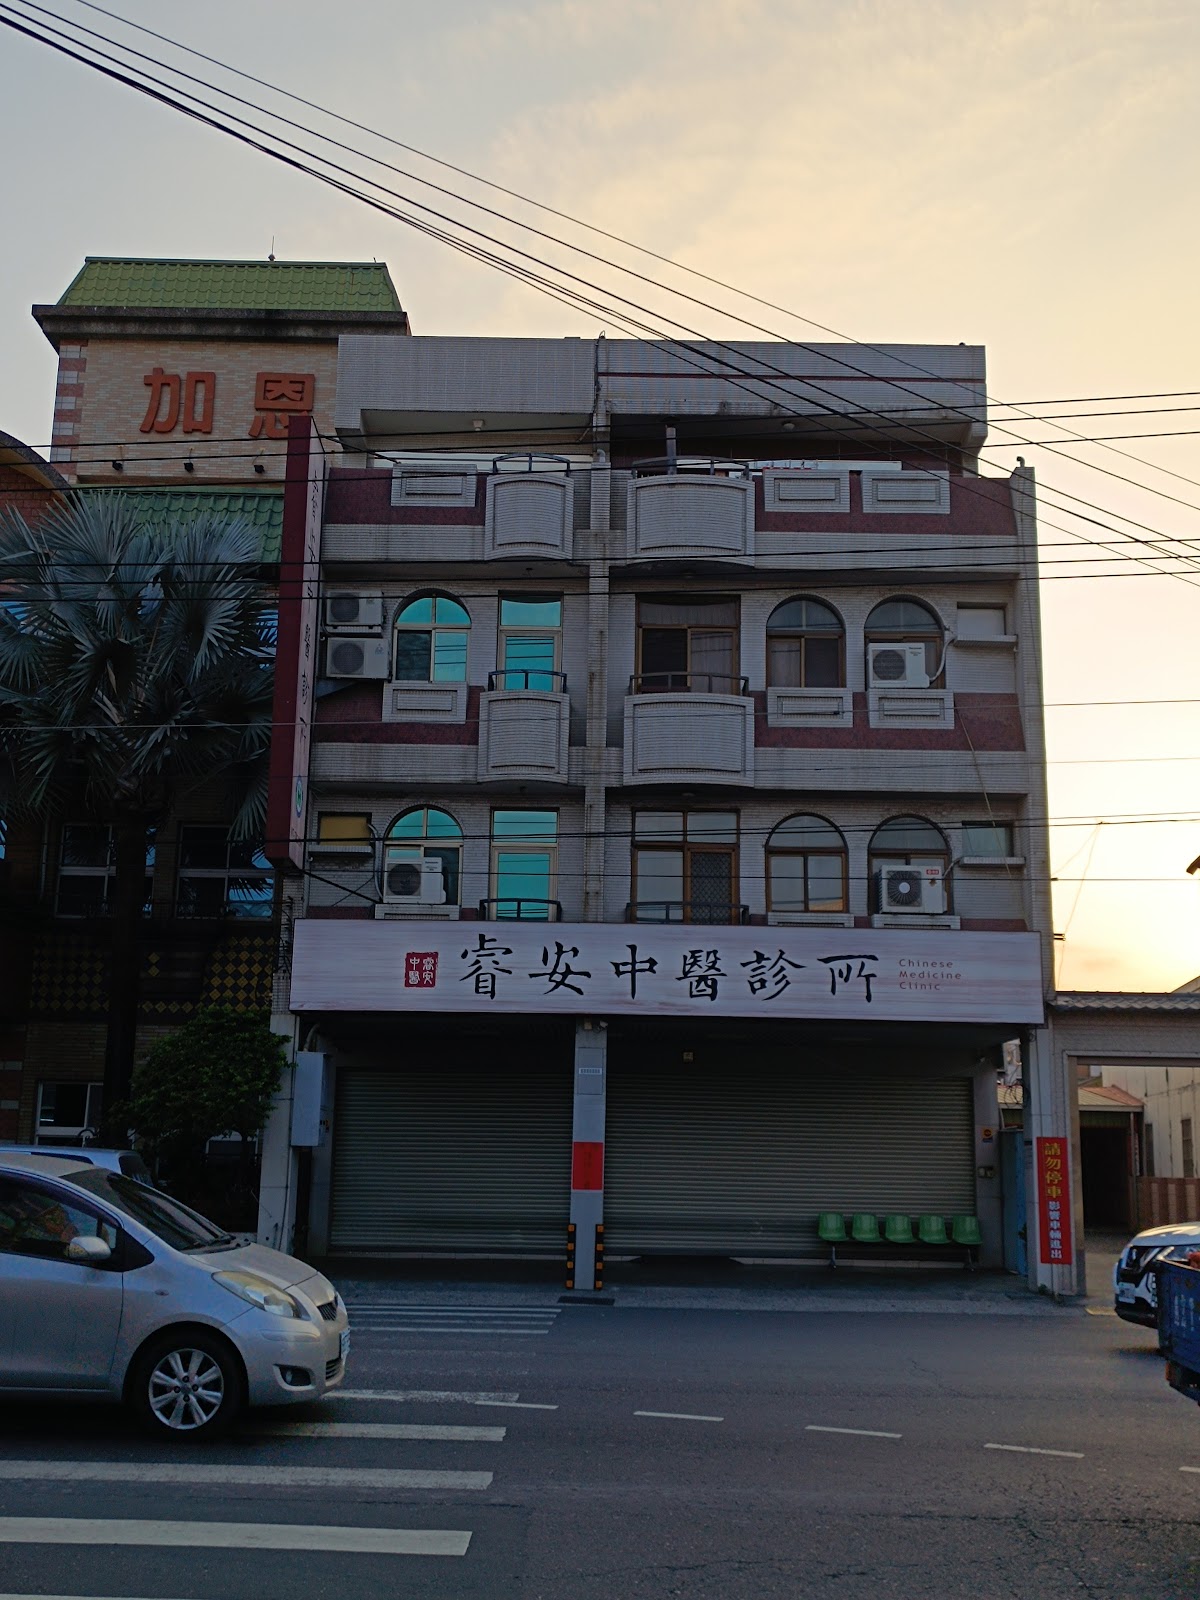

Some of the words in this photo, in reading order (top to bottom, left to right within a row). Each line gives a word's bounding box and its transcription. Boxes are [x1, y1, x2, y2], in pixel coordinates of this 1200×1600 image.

[139, 367, 315, 438] 加恩
[460, 933, 878, 1003] 睿安中醫診所
[899, 959, 953, 968] Chinese
[899, 971, 962, 980] Medicine
[900, 981, 940, 990] Clinic
[1044, 1142, 1062, 1199] 請勿停車
